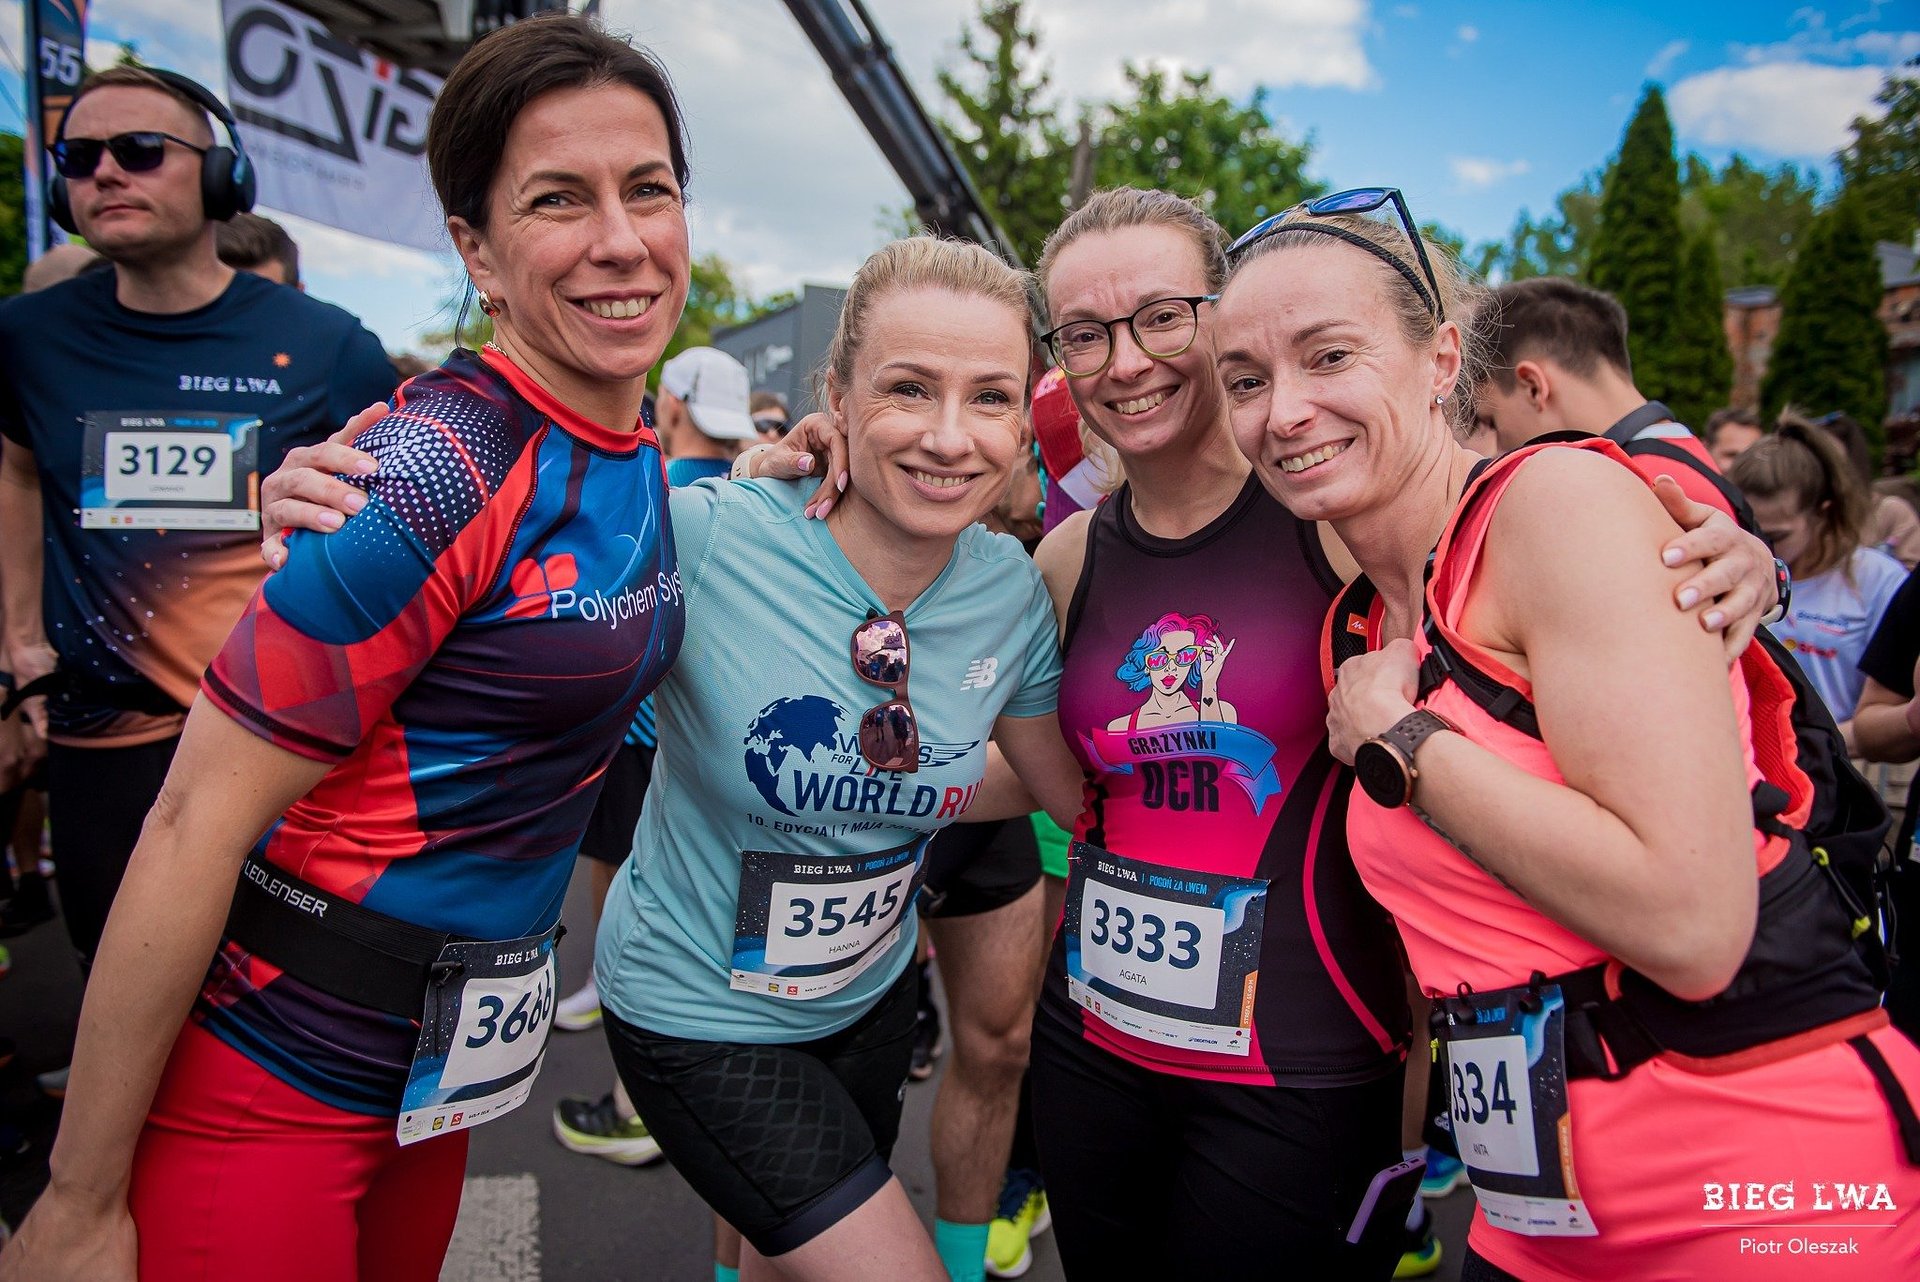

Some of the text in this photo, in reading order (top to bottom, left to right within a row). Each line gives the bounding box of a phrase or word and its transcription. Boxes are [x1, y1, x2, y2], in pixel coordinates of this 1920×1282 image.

[178, 375, 282, 395] BIEG LWA
[119, 445, 217, 475] 3129
[551, 584, 658, 630] Polychem
[831, 754, 853, 764] FOR
[793, 770, 984, 818] WORLD RU
[747, 813, 768, 828] 10.
[774, 821, 827, 837] EDYCJA
[841, 823, 848, 836] 7
[851, 822, 883, 833] MAJA
[793, 864, 823, 875] BIEG
[828, 864, 852, 875] LWA
[1097, 861, 1115, 875] BIEG
[1117, 867, 1137, 882] LWA
[244, 860, 328, 918] LEDLENSER
[784, 880, 902, 938] 3545
[1090, 899, 1202, 970] 3333
[495, 951, 523, 965] BIEG
[828, 940, 861, 954] HANNA
[1118, 969, 1147, 985] AGATA
[465, 969, 552, 1048] 3666
